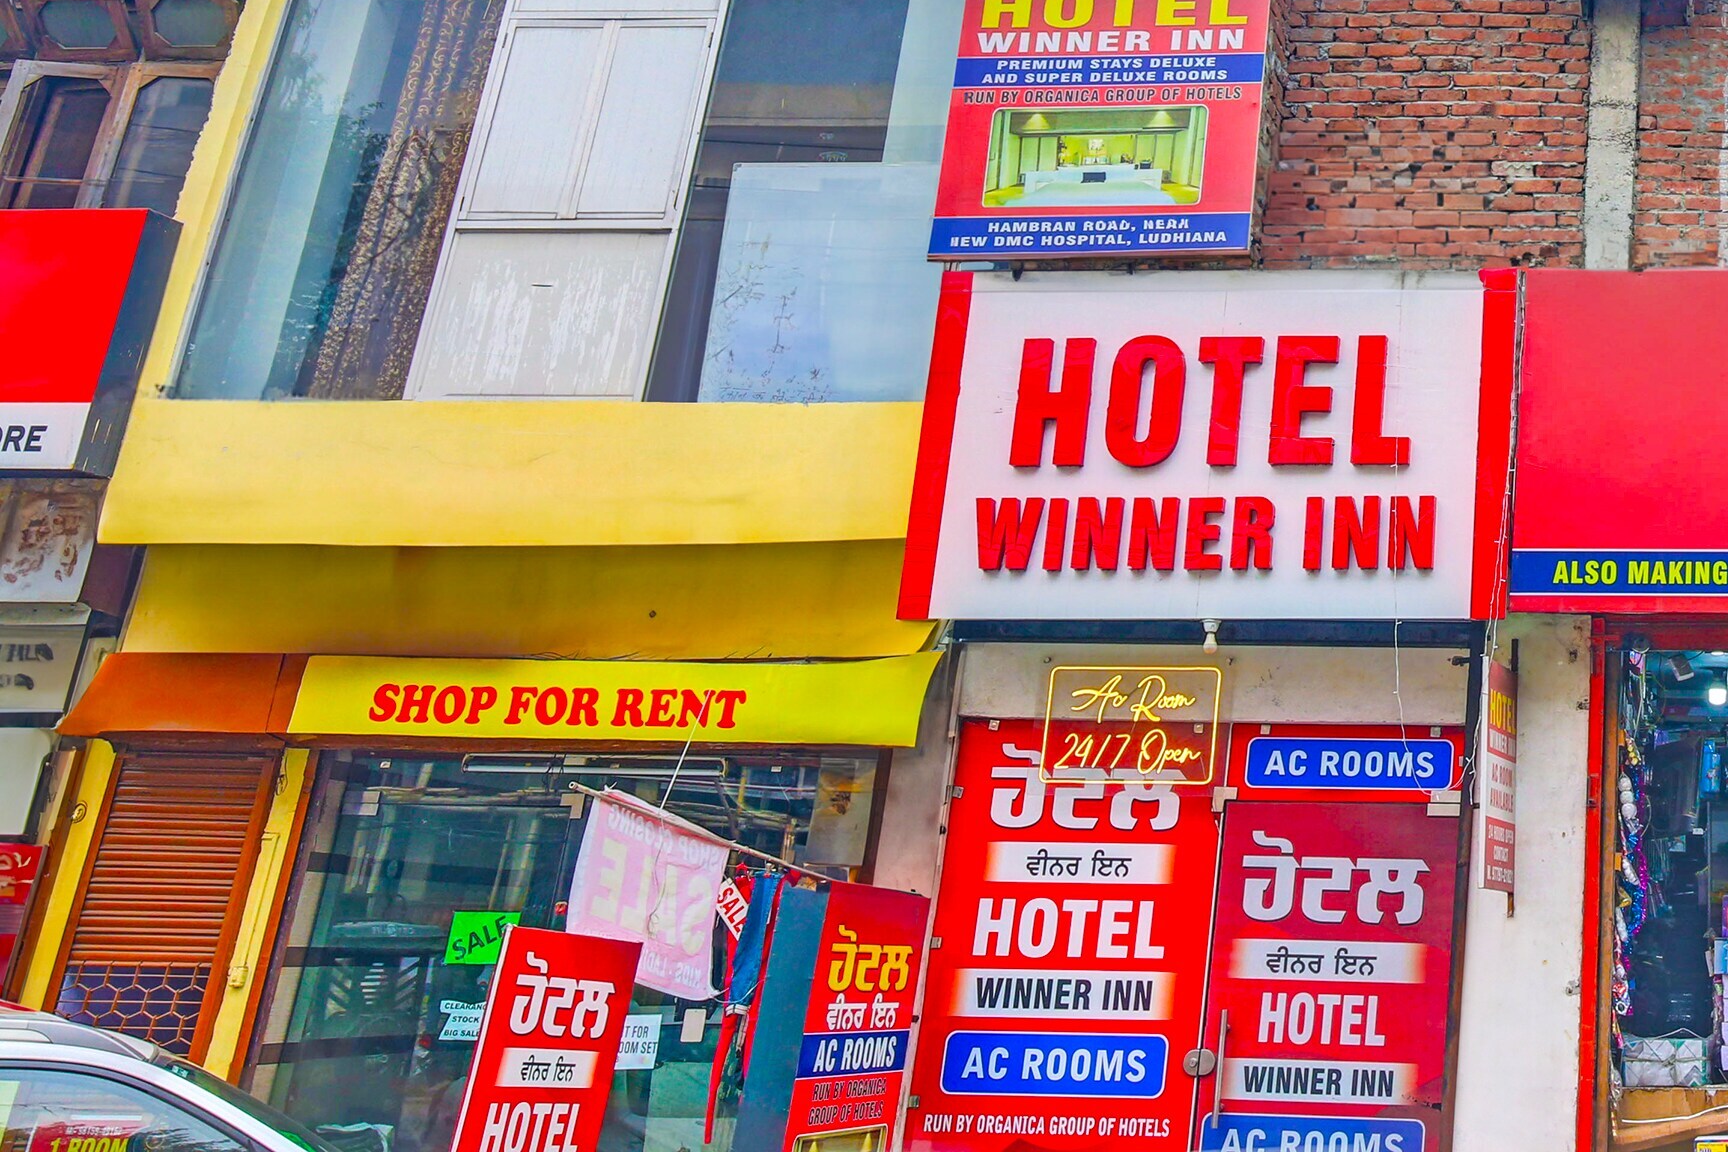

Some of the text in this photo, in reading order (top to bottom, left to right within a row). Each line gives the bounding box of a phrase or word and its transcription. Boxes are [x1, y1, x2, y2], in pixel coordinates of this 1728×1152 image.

[977, 28, 1245, 54] WINNER INN
[981, 69, 1228, 84] AND SUPER DELUXE ROOMS
[996, 57, 1217, 70] PREMIUM STAYS DELUXE
[964, 86, 1241, 104] RUN BY ORGANICA GROUP OF HOTELS
[950, 231, 1227, 248] NEW DMC HOSPITAL, LUDHIANA
[987, 221, 1076, 233] HAMBRAN
[1082, 220, 1136, 233] ROAD,
[1009, 335, 1411, 468] HOTEL
[976, 496, 1437, 572] WINNER INN
[1552, 561, 1617, 585] ALSO
[1627, 561, 1728, 585] MAKING
[369, 683, 747, 729] SHOP FOR RENT
[1071, 674, 1196, 723] Ac Room
[1489, 688, 1517, 735] HOTEL
[1054, 729, 1202, 775] 24/7 Open
[1263, 750, 1439, 778] AC ROOMS
[990, 743, 1188, 832] ਹੋਟਲ
[1025, 848, 1133, 877] ਵੀਨਰ ਇਨ
[1241, 830, 1431, 926] ਹੋਟਲ
[452, 915, 508, 960] SALE
[972, 897, 1165, 960] HOTEL
[827, 925, 913, 992] ਹੋਟਲ
[1266, 947, 1377, 974] ਵੀਨਰ ਇਨ
[509, 951, 616, 1039] ਹੋਟਲ
[826, 993, 899, 1030] ਵੀਨਰ ਇਨ
[975, 978, 1154, 1012] WINNER INN
[632, 1026, 649, 1038] FOR
[1257, 993, 1386, 1047] HOTEL
[640, 1042, 658, 1054] SET
[813, 1035, 897, 1073] AC ROOMS
[961, 1047, 1148, 1082] AC ROOMS
[520, 1055, 576, 1082] ਵੀਨਰ ਇਨ
[1242, 1066, 1394, 1098] WINNER INN
[812, 1077, 887, 1101] RUN BY ORGANICA
[479, 1101, 581, 1152] HOTEL
[808, 1101, 884, 1126] GROUP OF HOTELS
[923, 1114, 1170, 1138] RUN BY ORGANICA GROUP OF HOTELS
[1224, 1128, 1404, 1152] AC ROOMS
